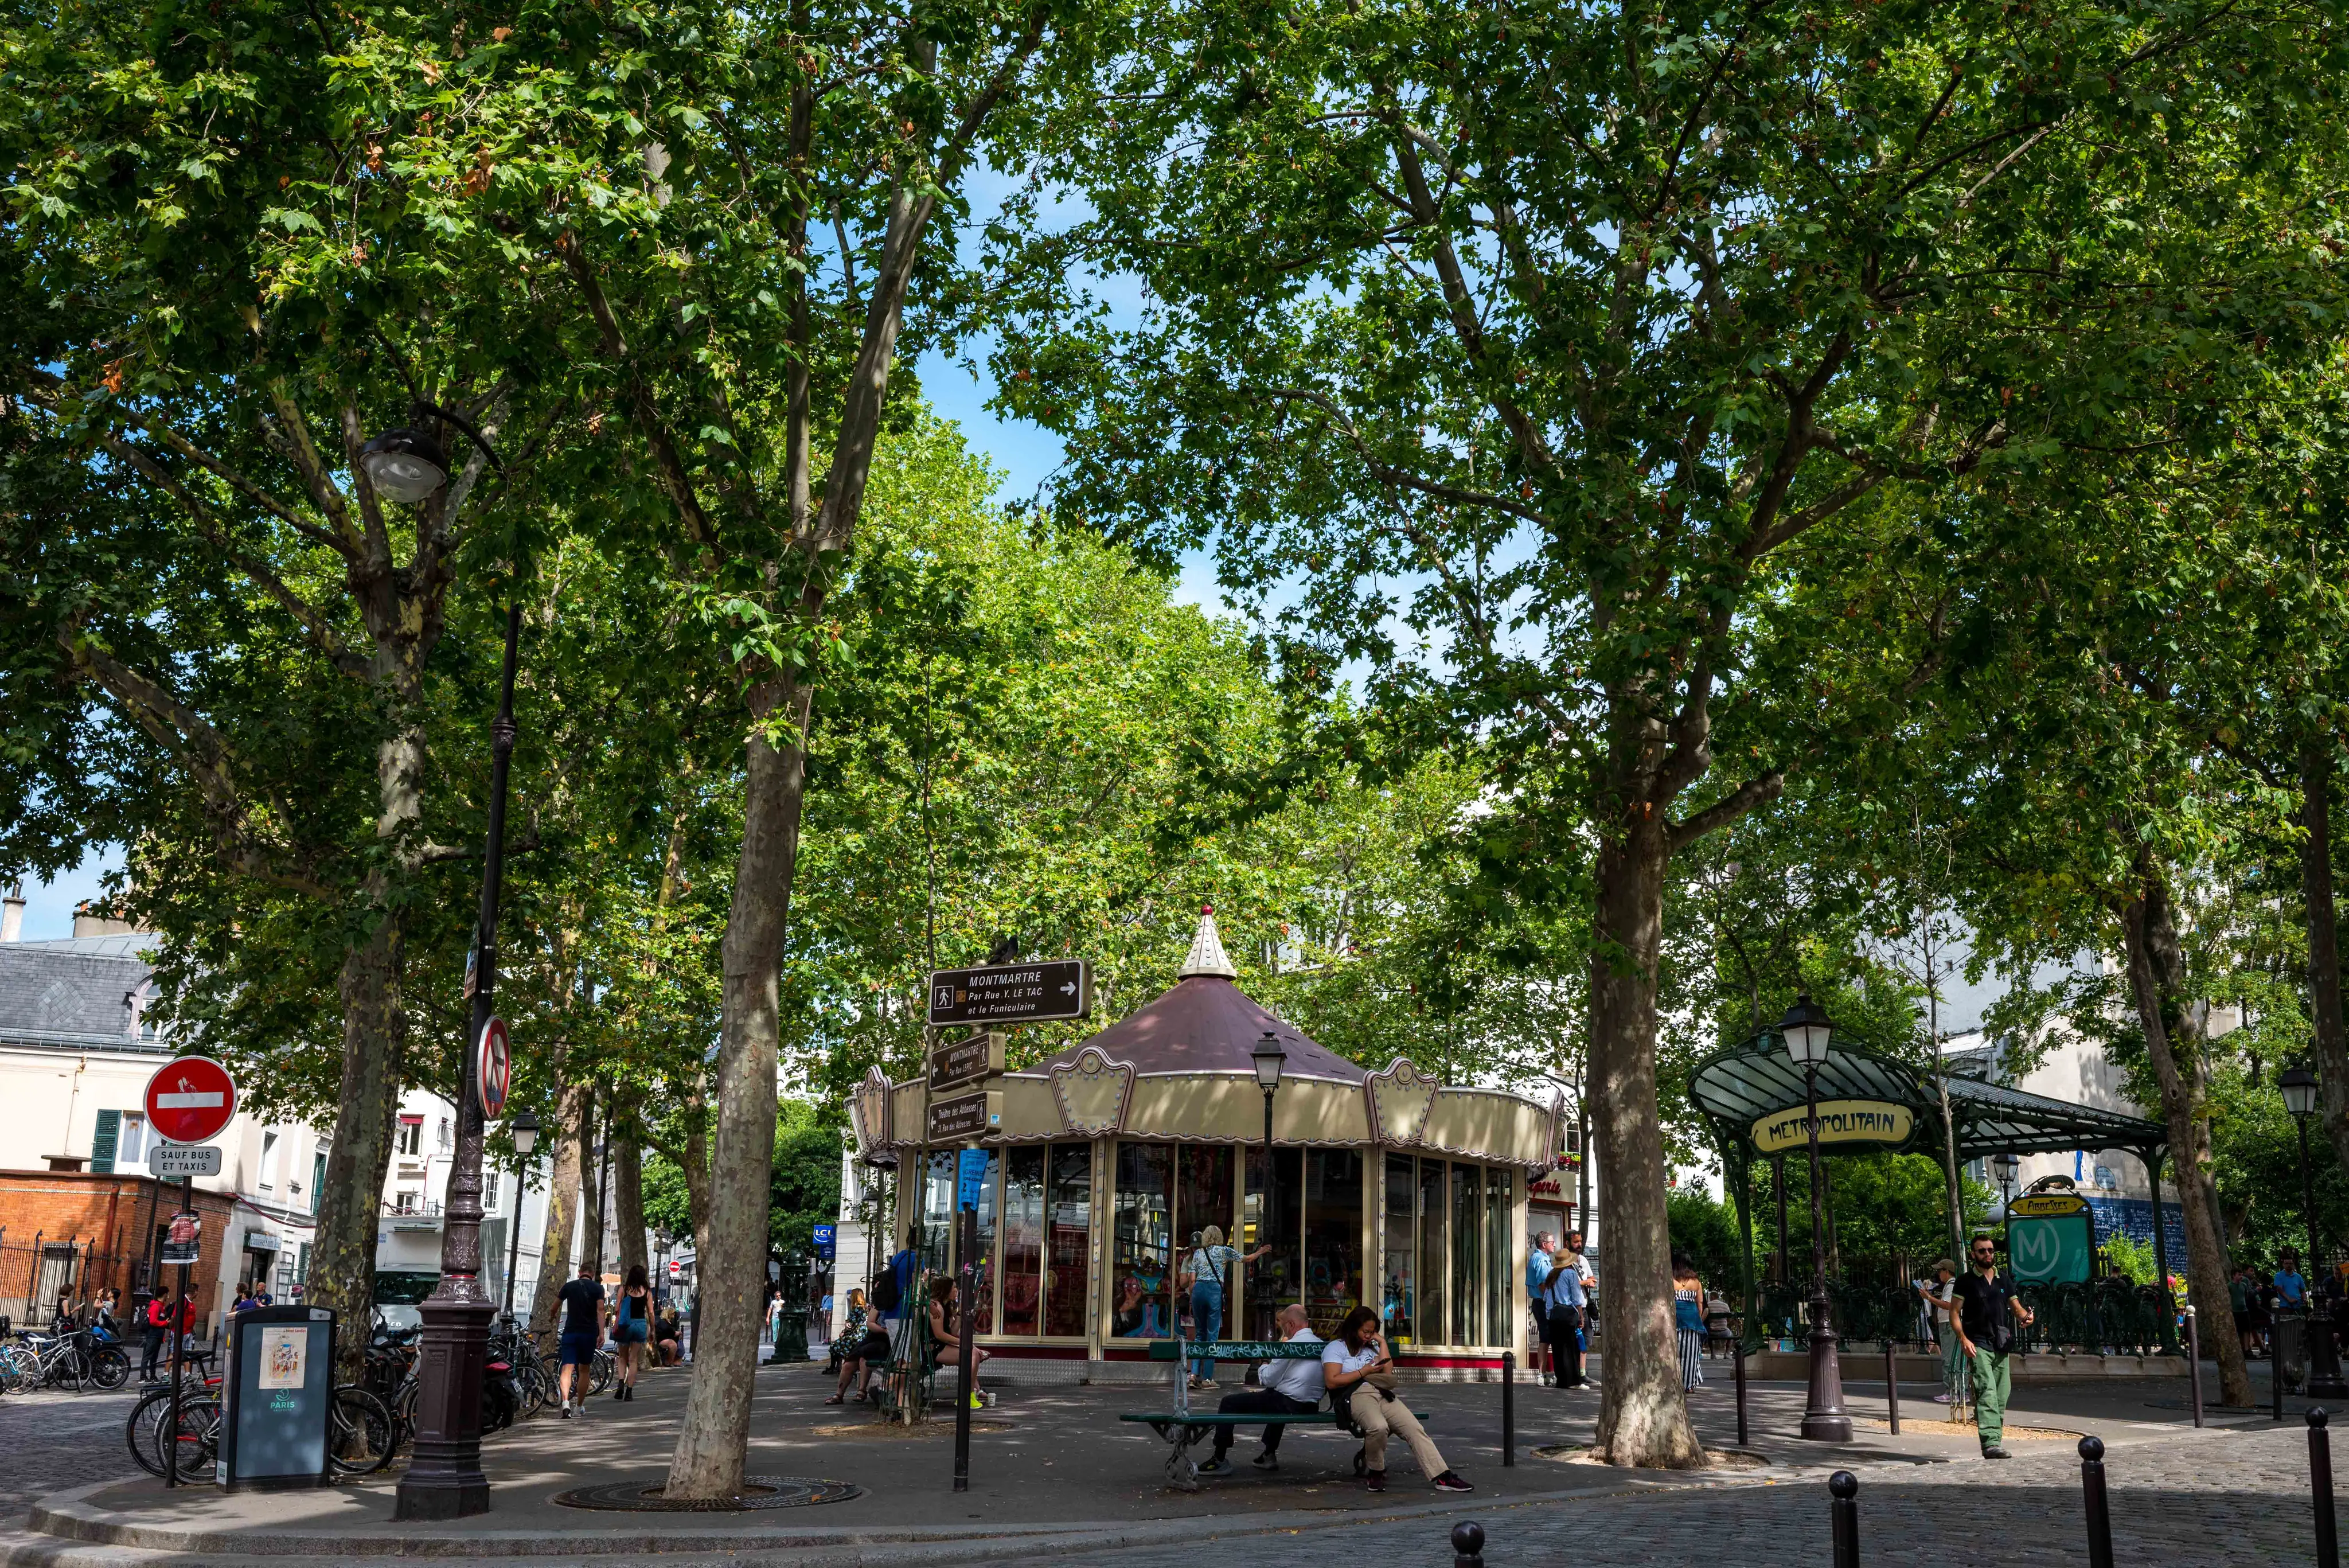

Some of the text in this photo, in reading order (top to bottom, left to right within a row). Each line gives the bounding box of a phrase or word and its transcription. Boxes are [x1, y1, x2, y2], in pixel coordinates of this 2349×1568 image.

[969, 972, 1041, 987] MONTMARTRE
[969, 992, 982, 1000] Par
[985, 990, 1000, 999] Rue
[1013, 989, 1023, 997] LE
[1027, 987, 1043, 996] TAC
[968, 1003, 1035, 1015] et le Funiculaire
[950, 1044, 979, 1063] MONTMARTRE
[962, 1062, 973, 1072] LEPIC
[938, 1107, 951, 1119] Théâtre
[959, 1103, 976, 1115] Abbesses
[956, 1120, 971, 1129] Abbesses
[161, 1151, 188, 1159] SAUF
[2017, 1228, 2047, 1262] M
[271, 1401, 295, 1409] PARIS
